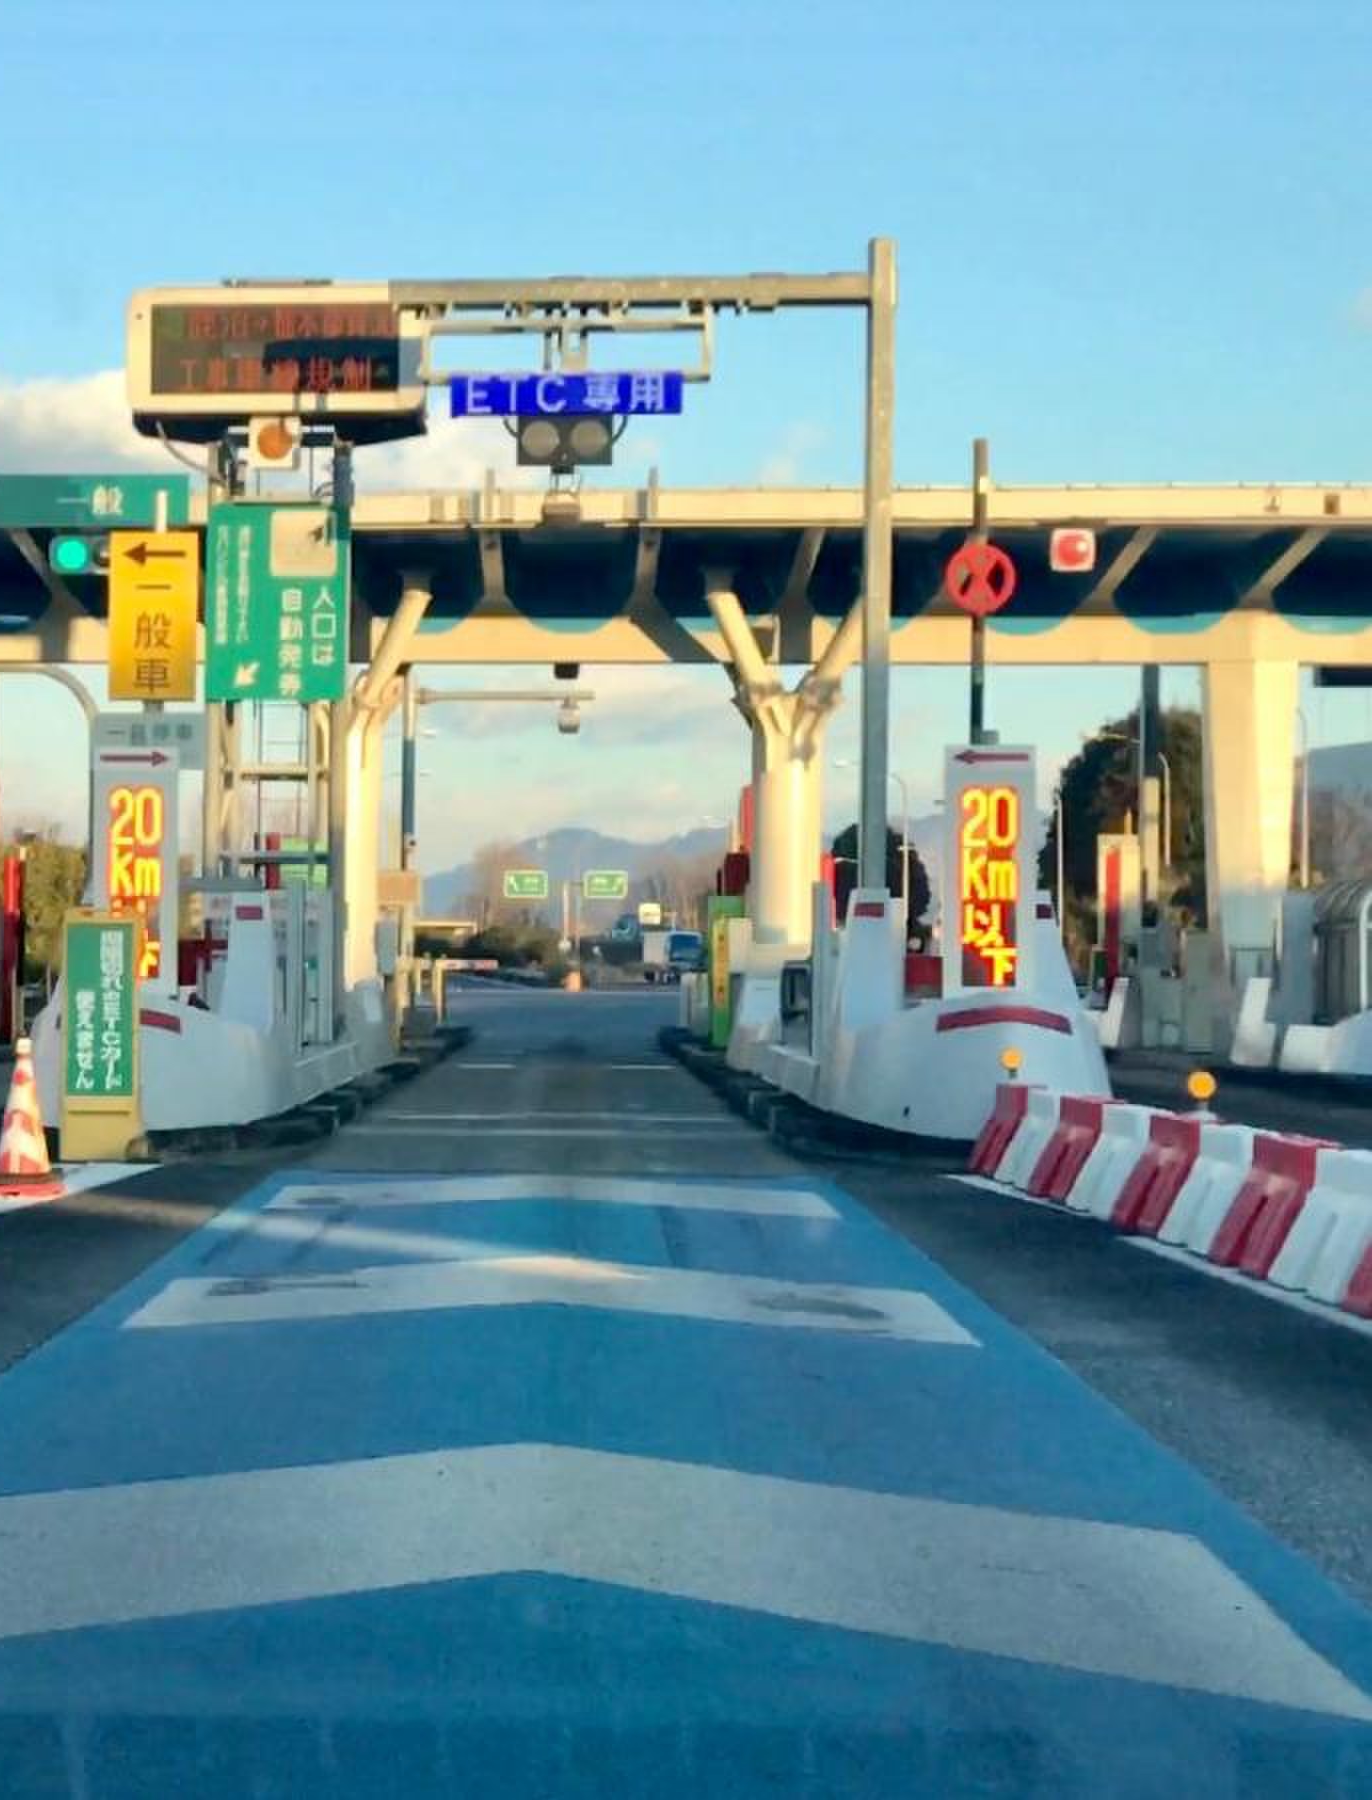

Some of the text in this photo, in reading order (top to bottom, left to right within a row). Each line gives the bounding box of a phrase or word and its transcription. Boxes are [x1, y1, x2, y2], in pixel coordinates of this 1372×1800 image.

[134, 583, 172, 693] 一般車
[110, 786, 163, 847] 20
[962, 788, 1019, 848] 20
